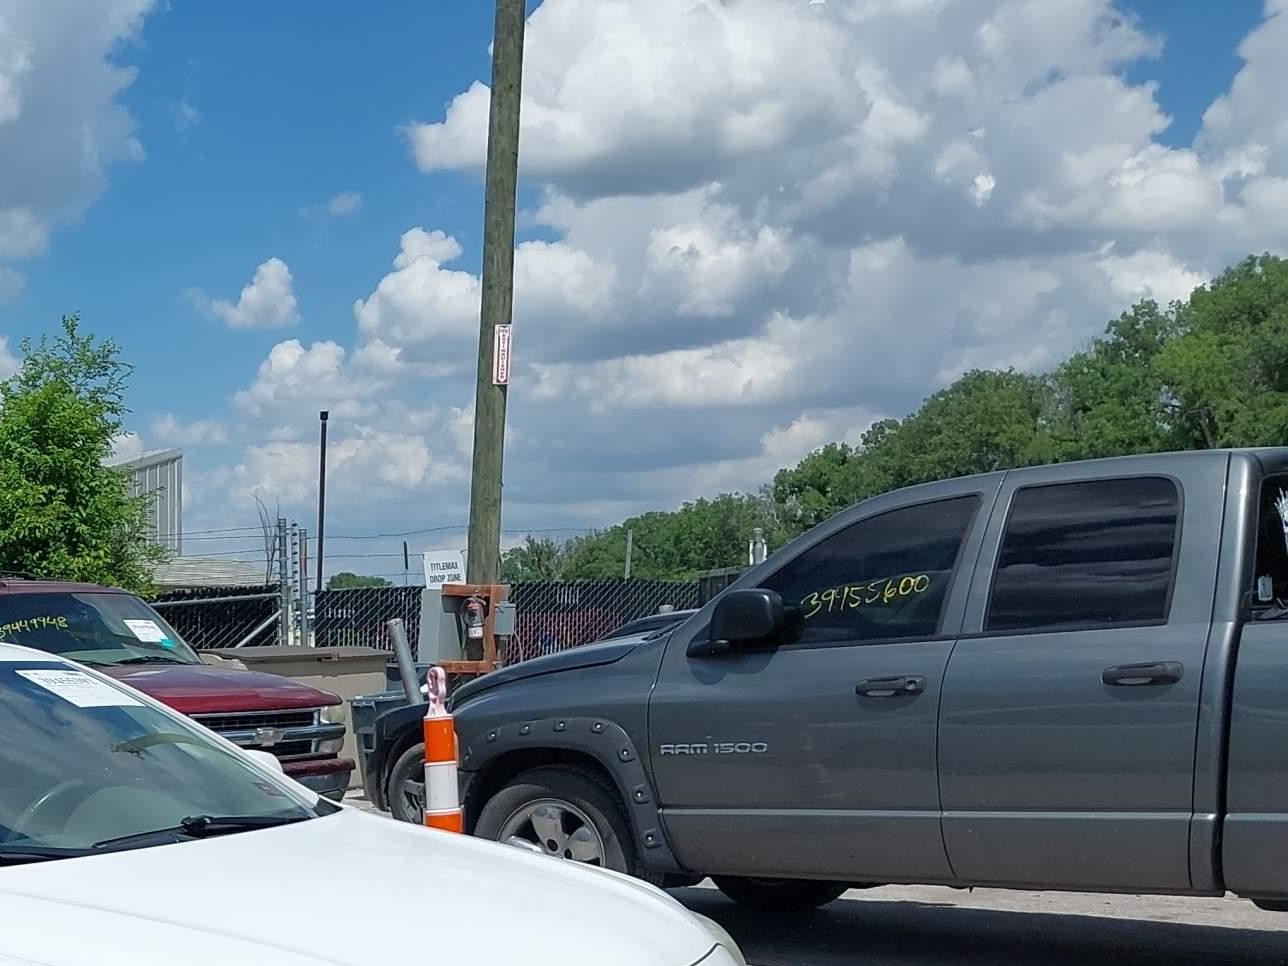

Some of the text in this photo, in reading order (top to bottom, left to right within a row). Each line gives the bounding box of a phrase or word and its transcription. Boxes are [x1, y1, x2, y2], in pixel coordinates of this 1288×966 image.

[430, 562, 459, 571] TITLEMAX
[429, 573, 464, 583] DROP ZONE
[660, 742, 768, 755] RAM 1500
